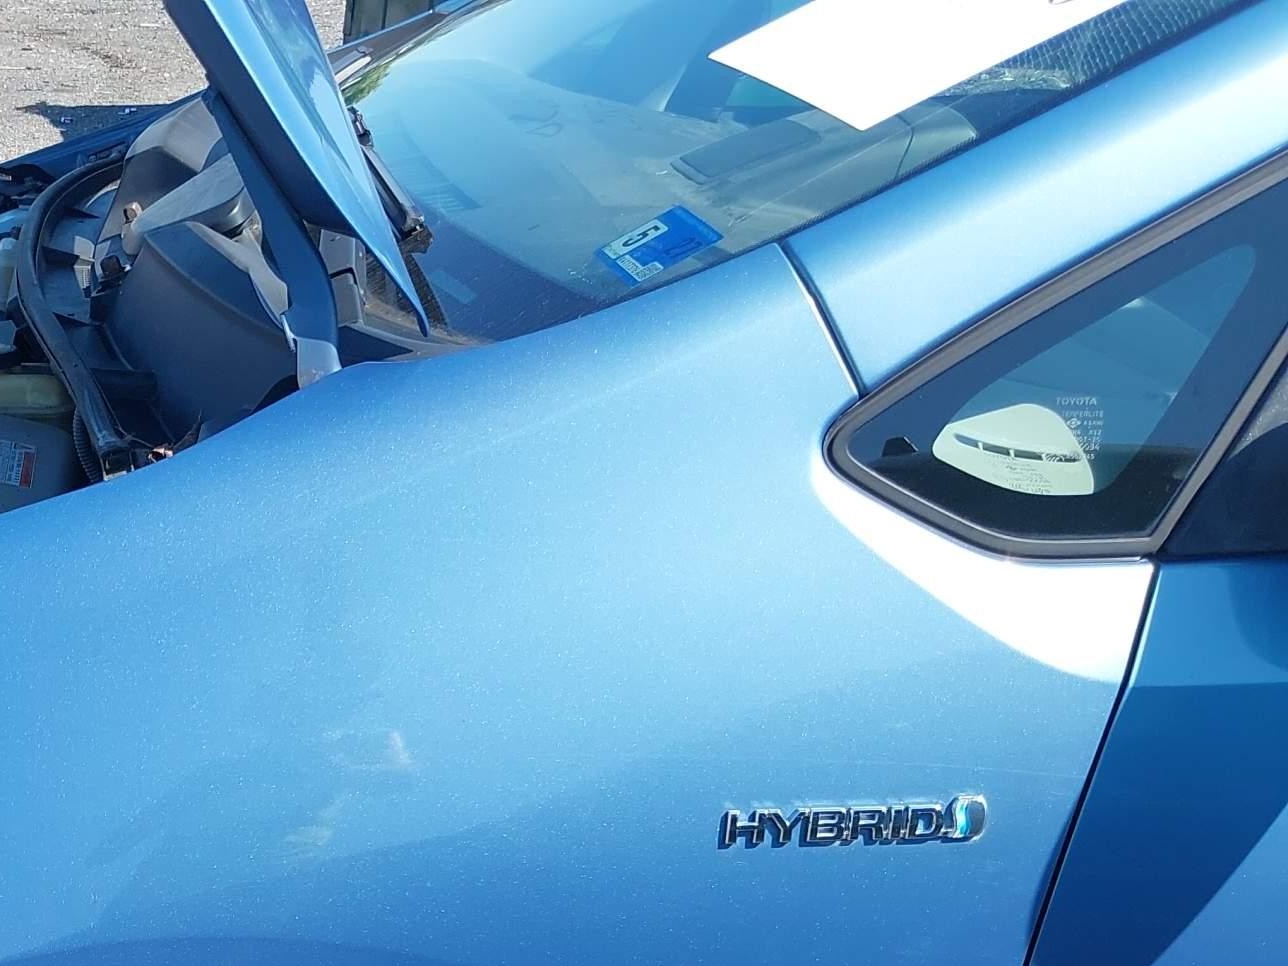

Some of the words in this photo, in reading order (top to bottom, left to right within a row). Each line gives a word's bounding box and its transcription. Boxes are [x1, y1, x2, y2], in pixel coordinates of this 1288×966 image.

[621, 224, 660, 248] 5
[1056, 396, 1097, 406] TOYOTA
[718, 803, 943, 849] HYBRID
